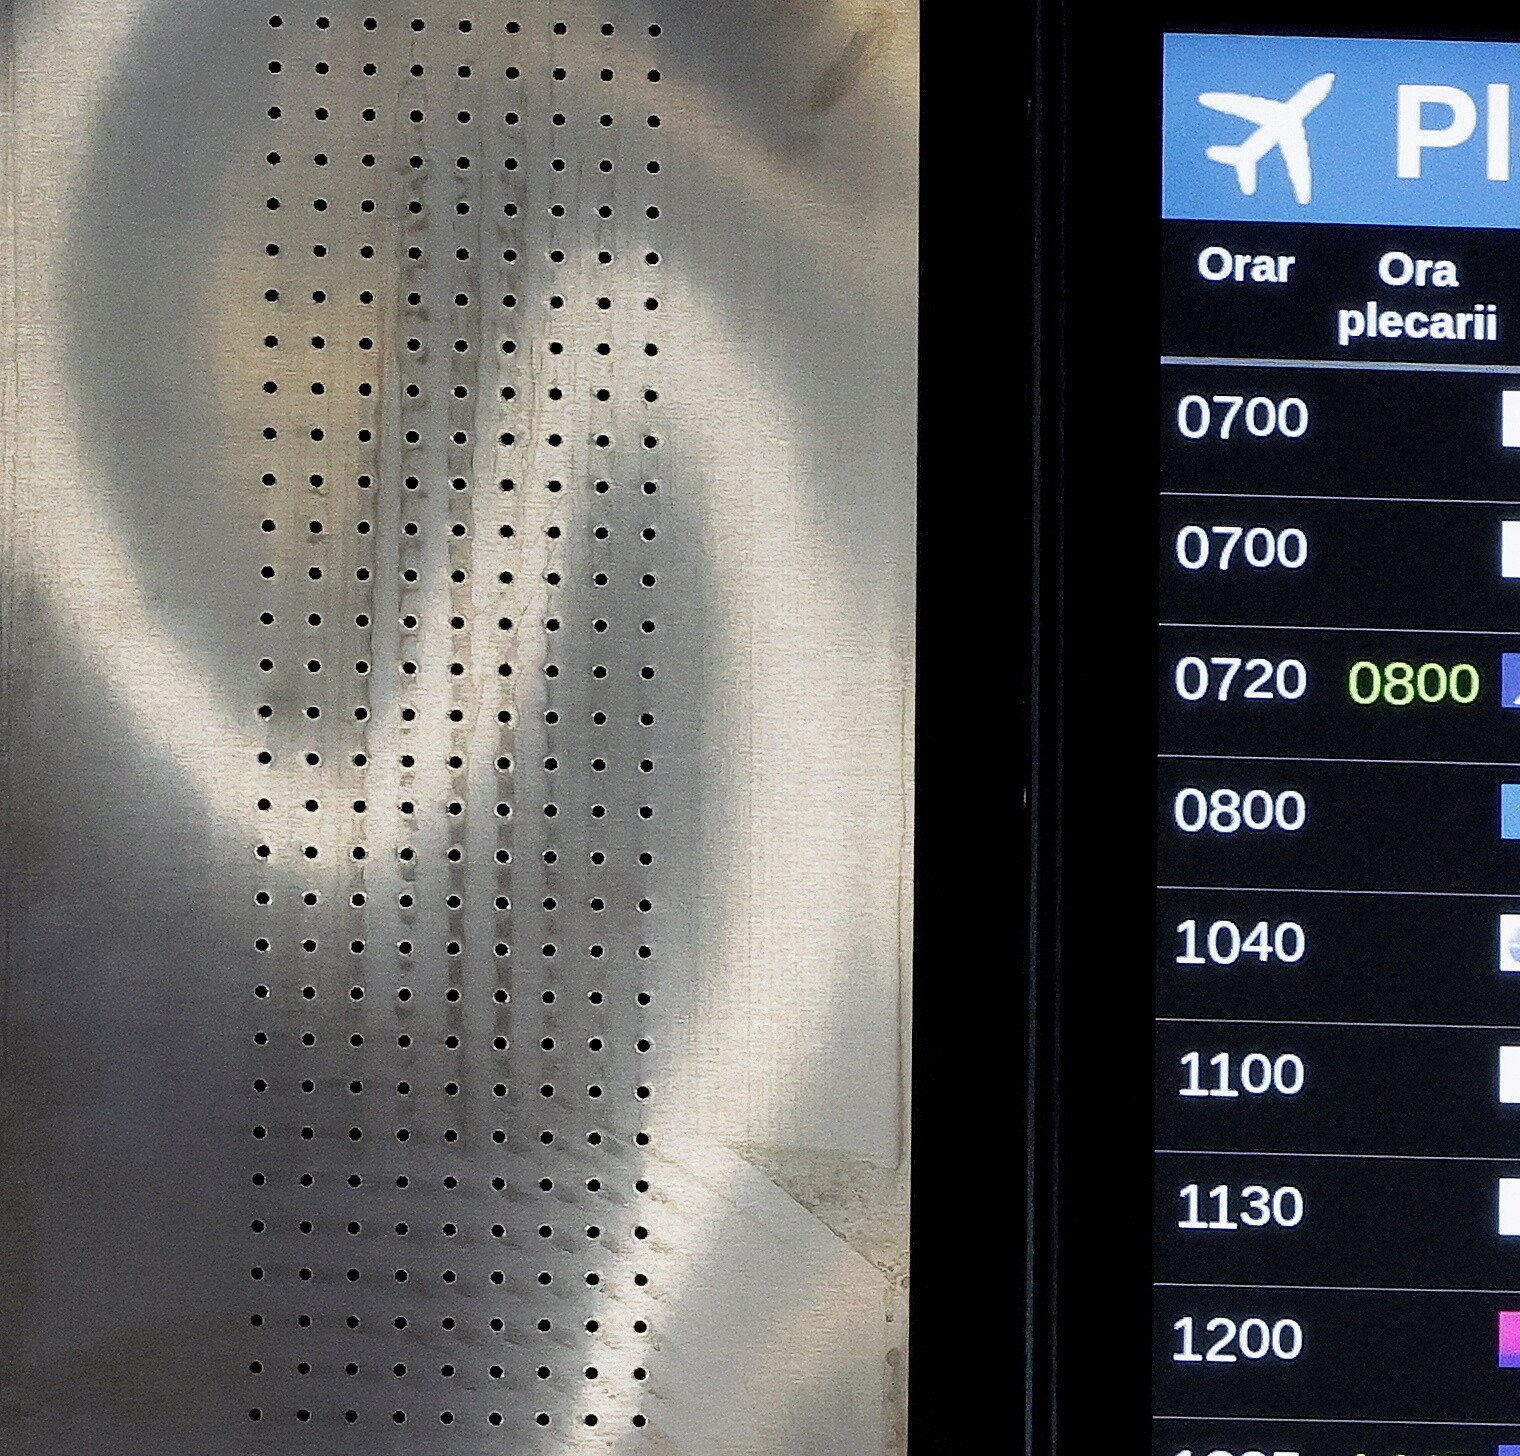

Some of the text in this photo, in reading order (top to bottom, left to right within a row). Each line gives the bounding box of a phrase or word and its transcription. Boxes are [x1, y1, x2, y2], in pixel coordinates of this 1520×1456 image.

[1198, 246, 1296, 283] Orar
[1379, 251, 1460, 288] Ora
[1338, 300, 1497, 346] plecarii
[1177, 394, 1309, 440] 0700
[1175, 525, 1308, 571] 0700
[1175, 656, 1307, 702] 0720
[1348, 661, 1480, 706] 0800
[1174, 787, 1306, 833] 0800
[1175, 919, 1306, 965] 1040
[1179, 1051, 1305, 1098] 1100
[1178, 1183, 1304, 1230] 1130
[1172, 1316, 1303, 1363] 1200
